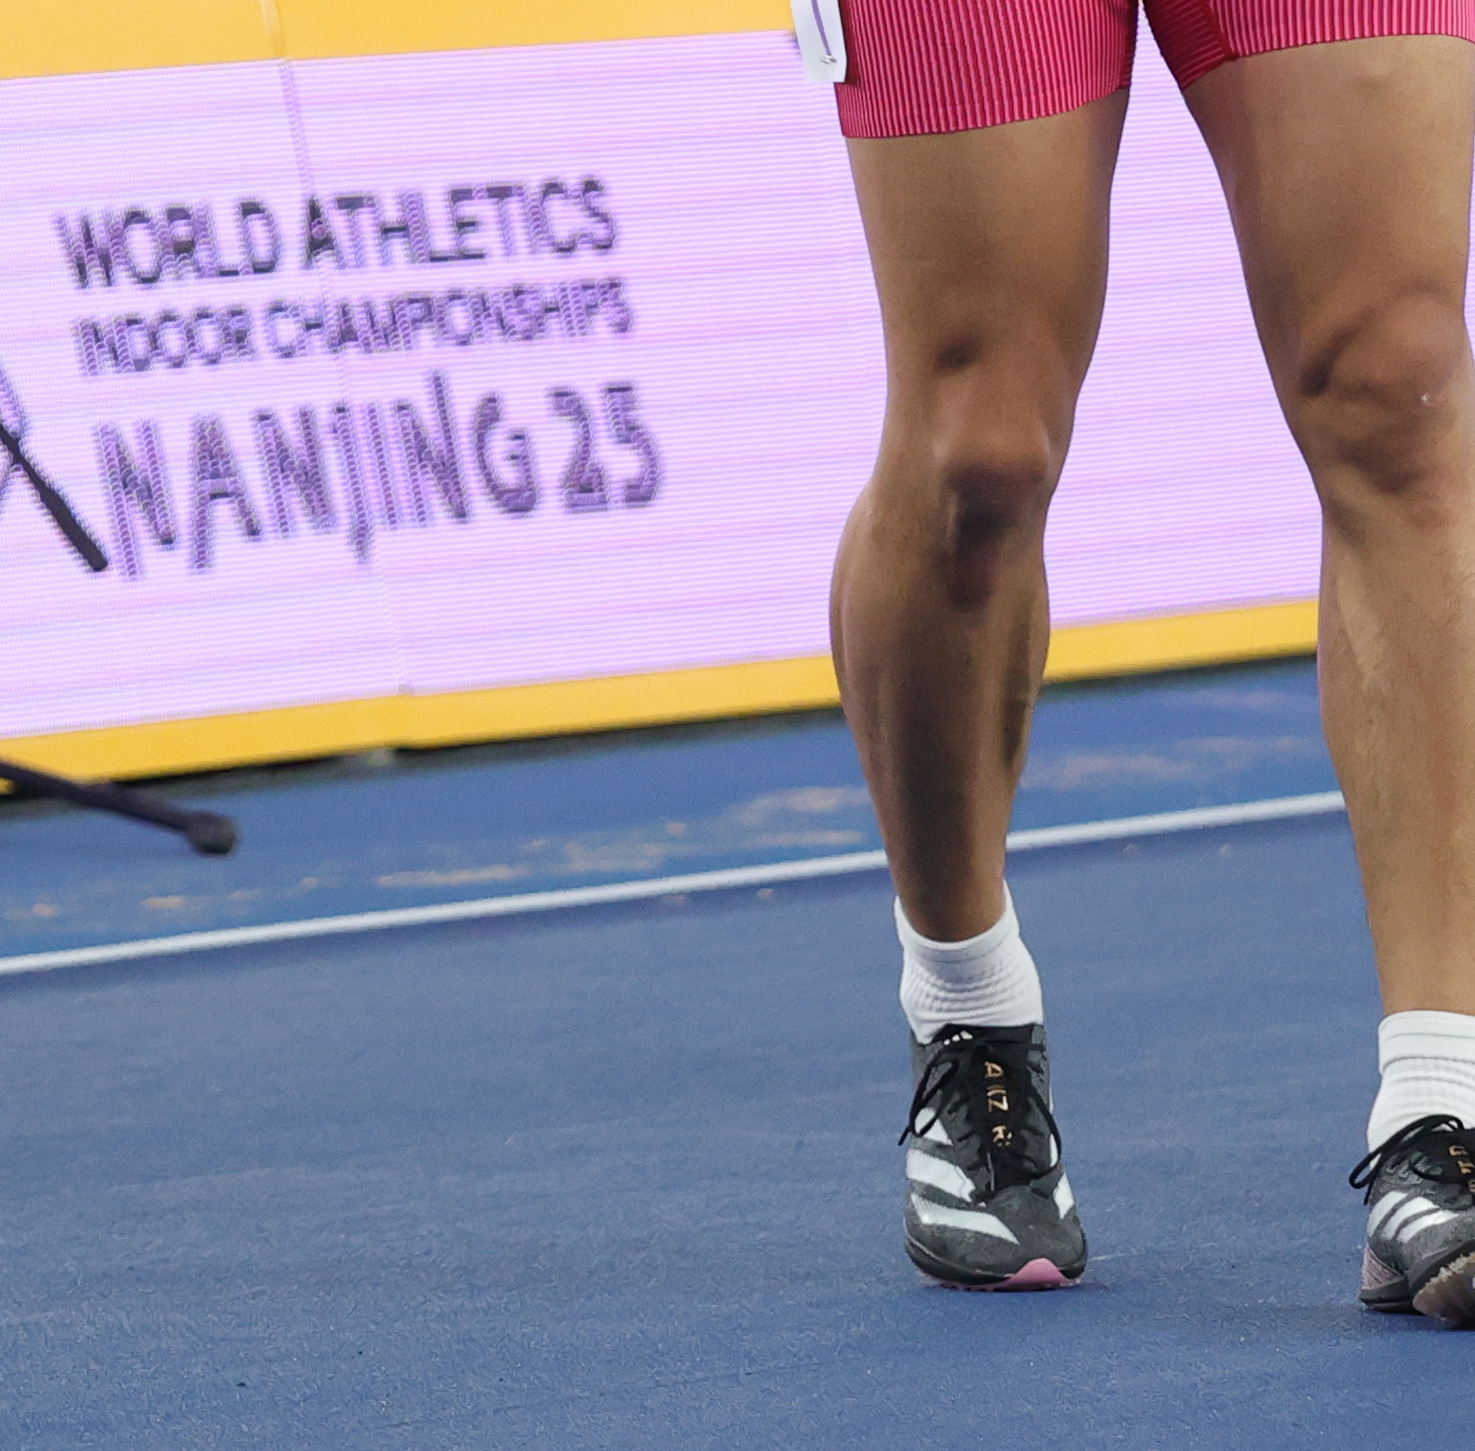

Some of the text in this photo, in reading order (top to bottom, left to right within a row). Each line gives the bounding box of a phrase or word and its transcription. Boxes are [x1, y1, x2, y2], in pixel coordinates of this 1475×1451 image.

[56, 174, 618, 288] WORLD ATHLETICS
[72, 275, 633, 376] INDOOR CHAMPIONSHIPS
